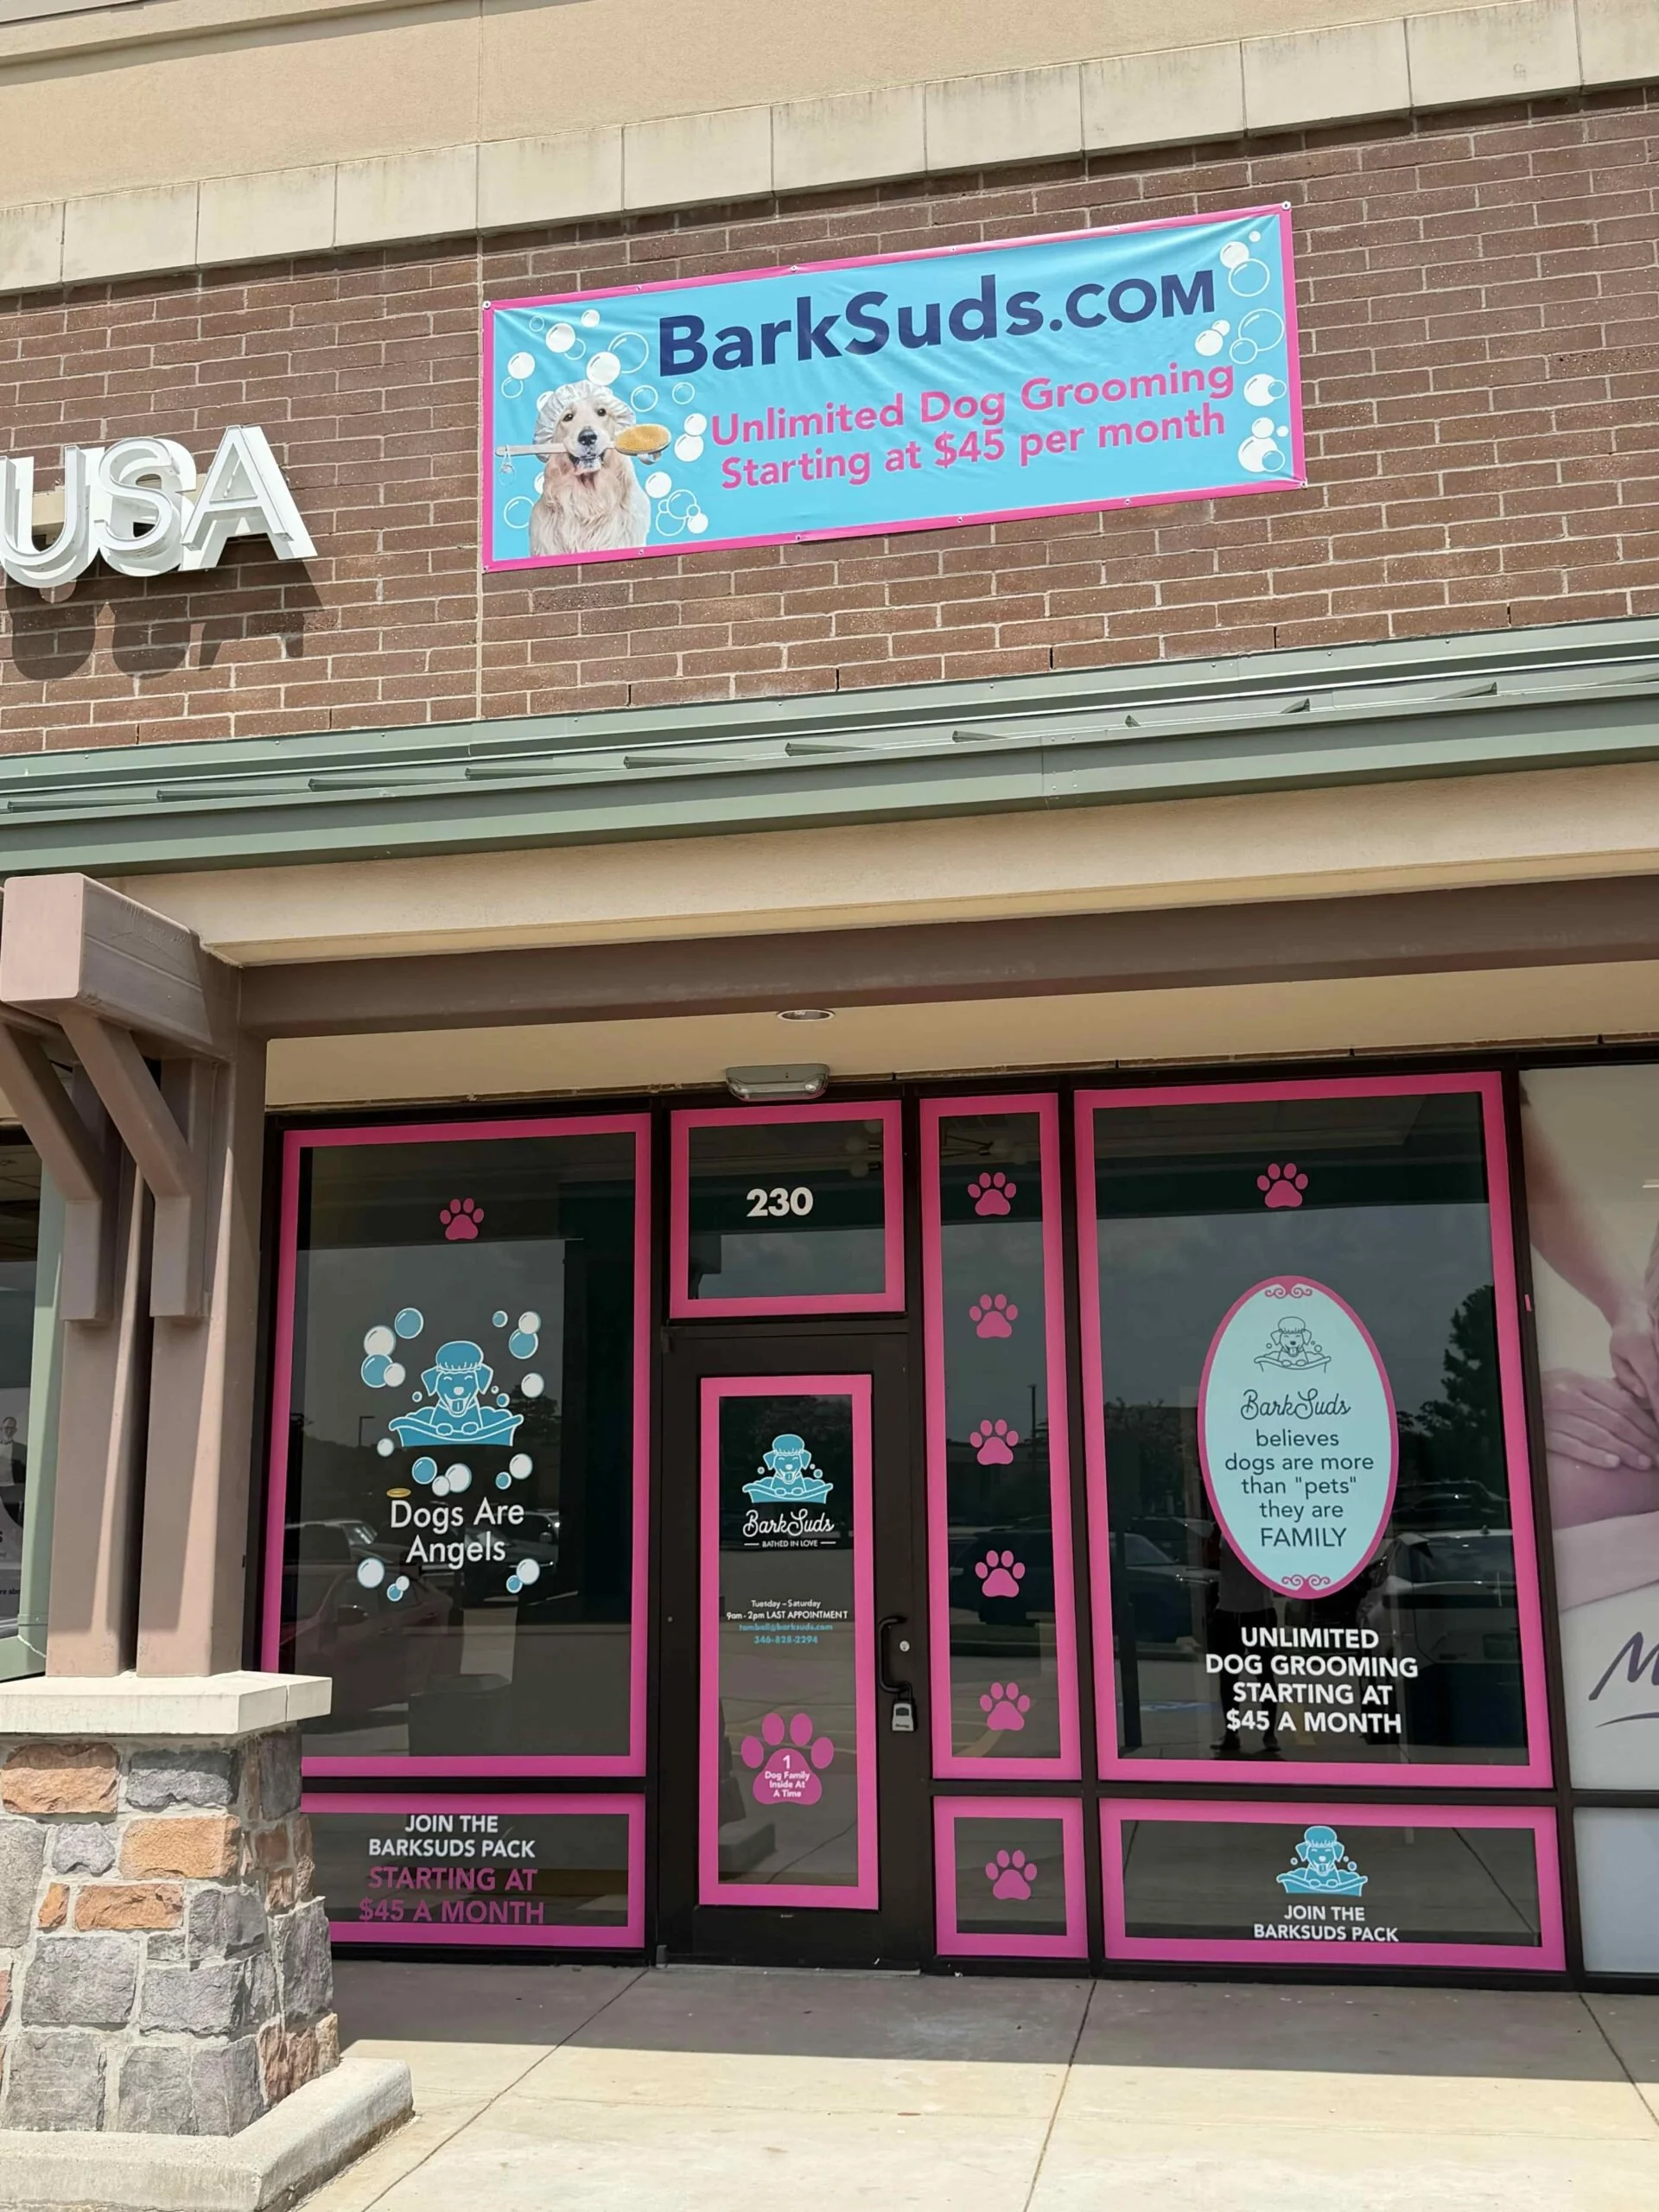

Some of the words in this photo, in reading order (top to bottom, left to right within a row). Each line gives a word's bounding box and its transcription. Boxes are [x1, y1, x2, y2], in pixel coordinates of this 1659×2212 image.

[659, 270, 1215, 376] BarkSuds.COM
[711, 392, 904, 446] Unlimited
[920, 391, 1006, 426] Dog
[1020, 362, 1234, 410] Grooming
[721, 447, 871, 490] Starting
[885, 441, 922, 472] at
[933, 429, 1006, 468] $45
[1020, 427, 1085, 467] per
[1097, 402, 1225, 448] month
[0, 424, 318, 588] USA
[746, 1186, 814, 1217] 230
[1239, 1387, 1352, 1421] BarkSuds
[1255, 1429, 1339, 1447] believes
[1224, 1452, 1275, 1475] dogs
[1281, 1456, 1314, 1471] are
[1320, 1456, 1375, 1471] more
[1241, 1476, 1287, 1495] than
[1294, 1476, 1357, 1500] "pets"
[391, 1499, 464, 1535] Dogs
[474, 1496, 524, 1526] Are
[742, 1508, 835, 1537] BarkSuds
[1258, 1500, 1306, 1522] they
[1311, 1503, 1344, 1518] are
[800, 1539, 818, 1548] LOVE
[1260, 1527, 1347, 1548] FAMILY
[405, 1530, 506, 1570] Angels
[726, 1611, 743, 1620] 9am
[747, 1611, 765, 1621] 2pm
[766, 1611, 785, 1619] LAST
[787, 1610, 848, 1619] APPOINTMENT
[751, 1599, 781, 1609] Tuesday
[787, 1599, 822, 1609] Saturday
[1240, 1626, 1380, 1649] UNLIMITED
[1205, 1654, 1263, 1675] DOG
[1270, 1655, 1419, 1678] GROOMING
[1233, 1681, 1355, 1705] STARTING
[1362, 1685, 1393, 1706] AT
[1225, 1708, 1270, 1732] $45
[1277, 1712, 1297, 1732] A
[1304, 1712, 1402, 1734] MONTH
[783, 1754, 791, 1770] 1
[765, 1770, 782, 1781] Dog
[784, 1770, 810, 1782] Family
[769, 1780, 793, 1789] Inside
[795, 1780, 805, 1789] At
[782, 1789, 802, 1797] Time
[404, 1815, 454, 1834] JOIN
[459, 1815, 499, 1834] THE
[368, 1839, 475, 1857] BARKSUDS
[481, 1840, 536, 1858] PACK
[368, 1866, 496, 1891] STARTING
[505, 1868, 537, 1891] AT
[359, 1897, 404, 1922] $45
[413, 1901, 432, 1922] A
[442, 1900, 544, 1924] MONTH
[1284, 1904, 1326, 1920] JOIN
[1331, 1906, 1365, 1922] THE
[1253, 1923, 1347, 1941] BARKSUDS
[1351, 1927, 1399, 1942] PACK
